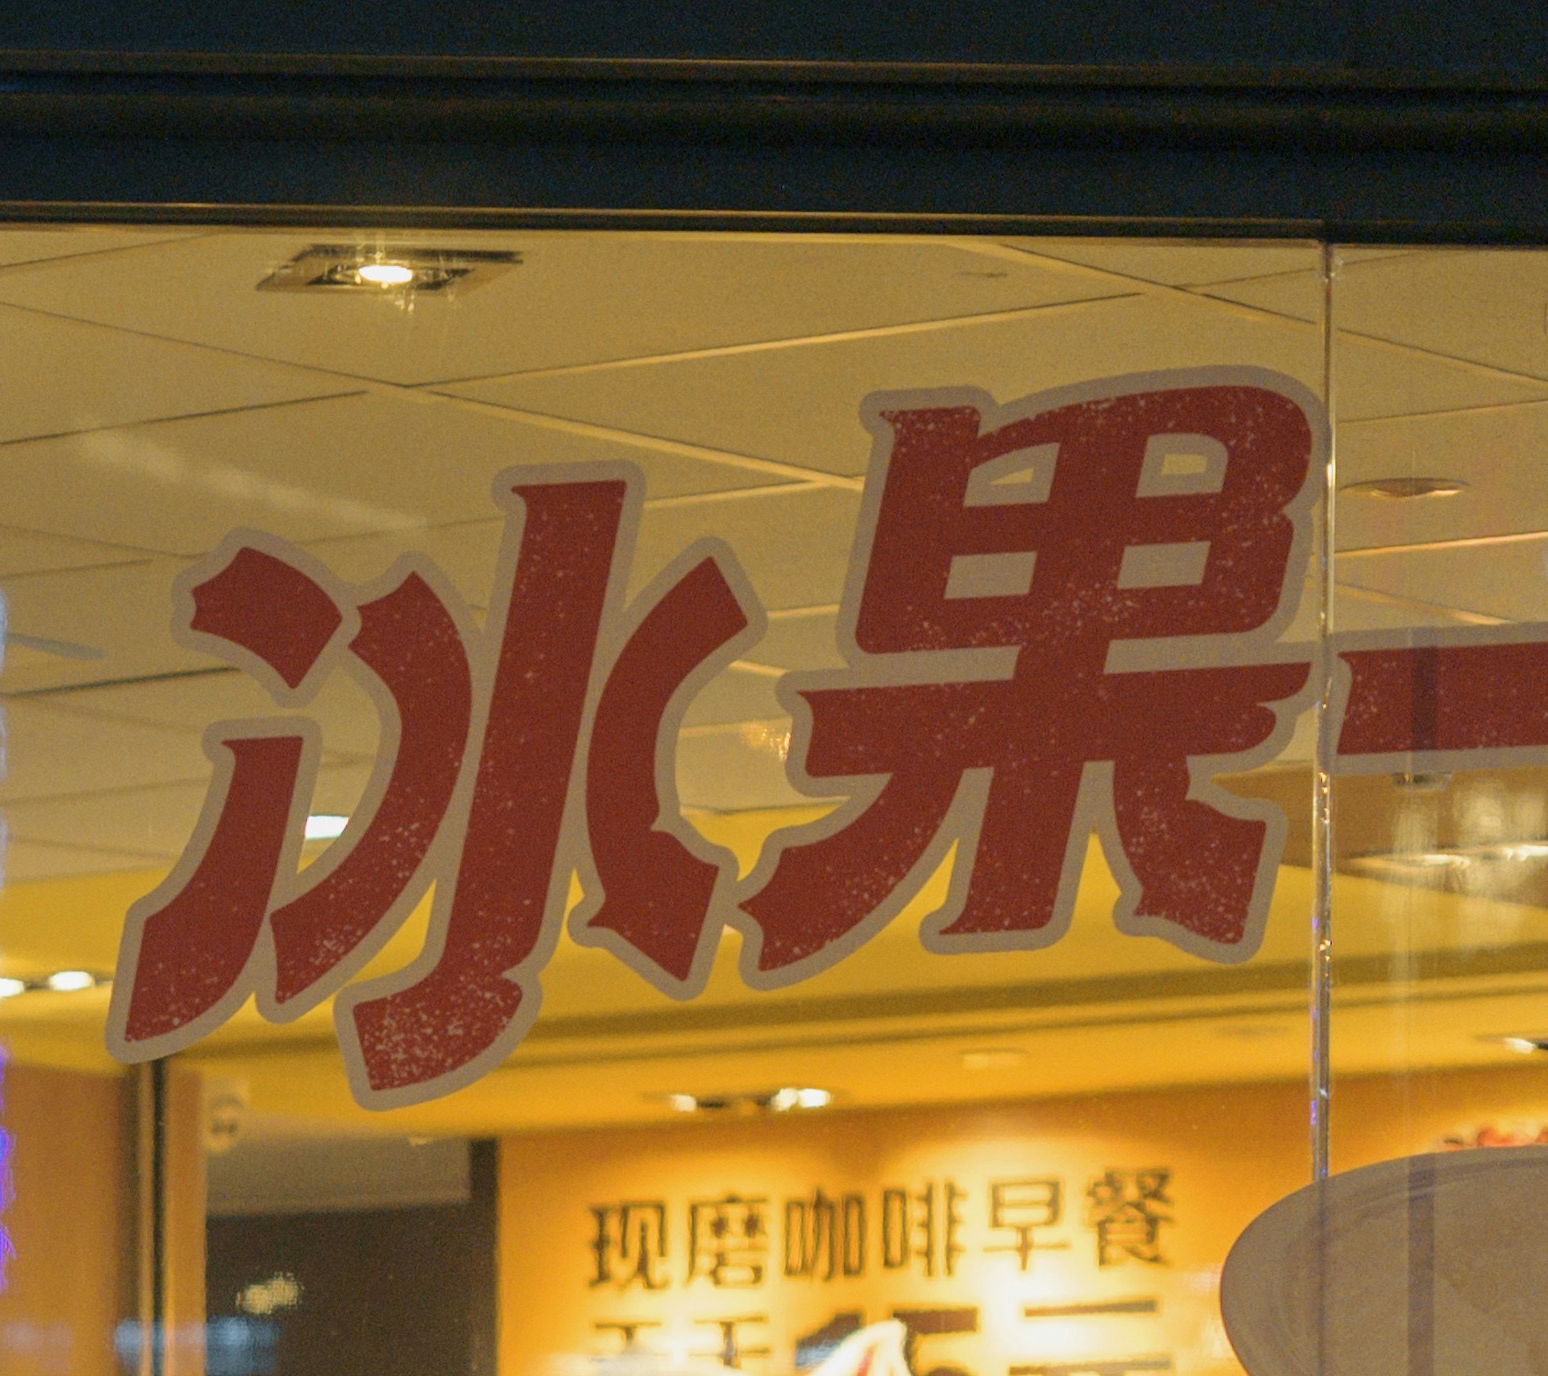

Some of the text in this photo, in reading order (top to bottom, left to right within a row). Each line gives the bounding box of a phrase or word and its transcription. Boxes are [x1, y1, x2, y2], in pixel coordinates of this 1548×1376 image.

[586, 1167, 1176, 1289] 现磨咖啡早餐
